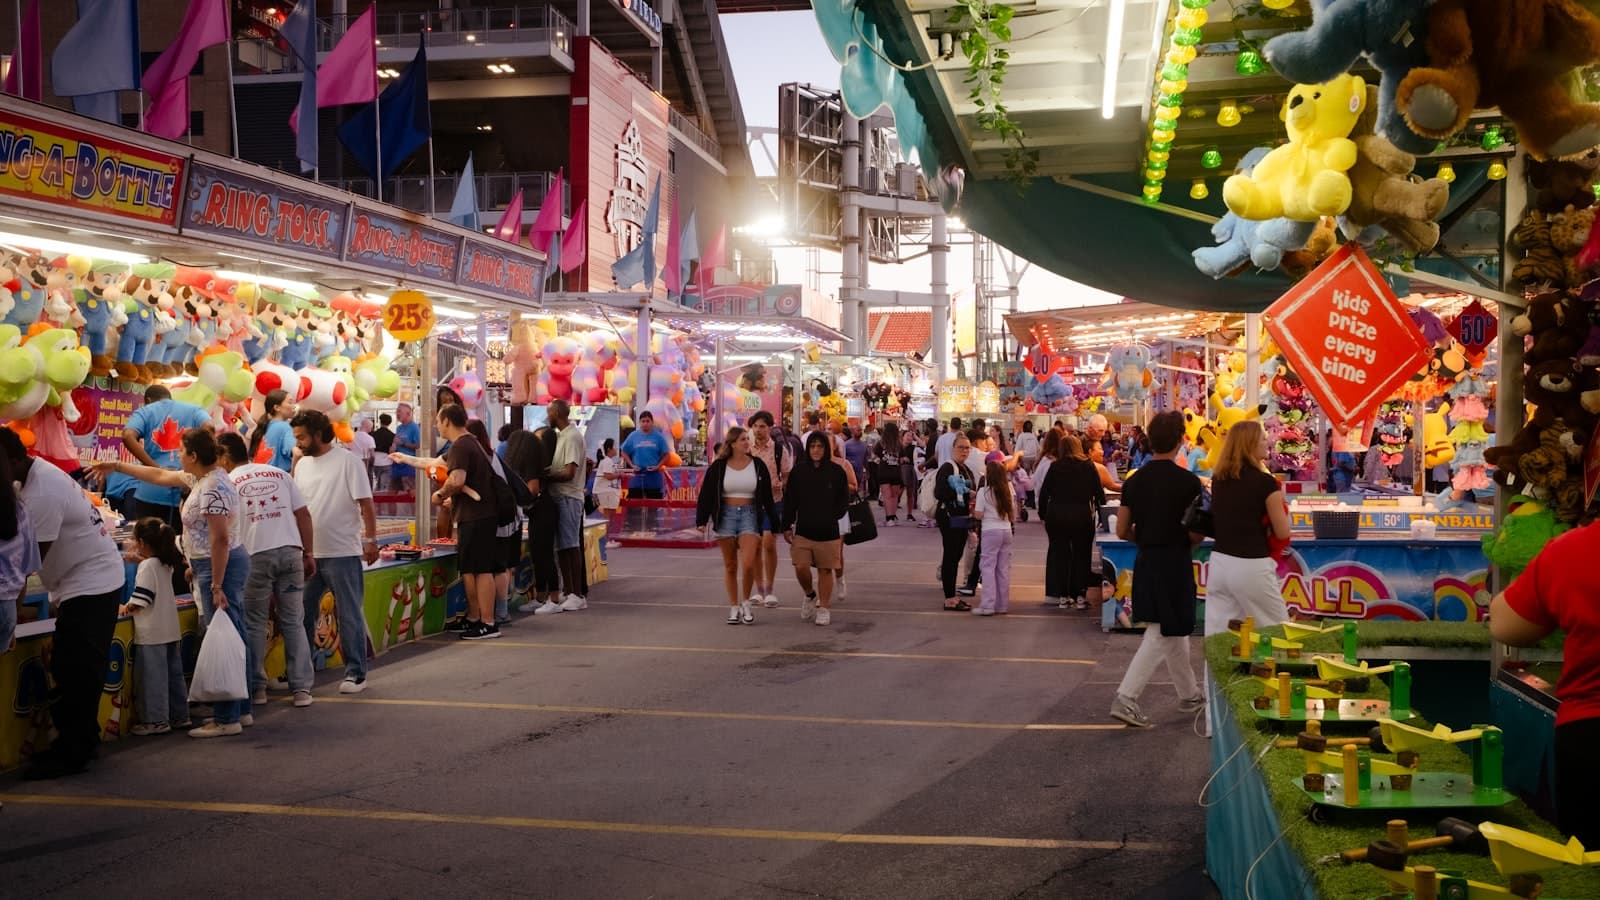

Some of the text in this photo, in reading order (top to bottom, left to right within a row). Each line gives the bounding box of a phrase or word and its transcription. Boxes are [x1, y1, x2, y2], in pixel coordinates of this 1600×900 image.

[204, 182, 330, 248] RING TOSS
[351, 214, 456, 268] RING-A-BOTTLE
[470, 251, 536, 296] RING TOSS
[388, 303, 432, 332] 25¢
[1323, 334, 1377, 365] every
[1321, 356, 1367, 385] time
[96, 444, 119, 462] bottle
[255, 471, 284, 480] POINT
